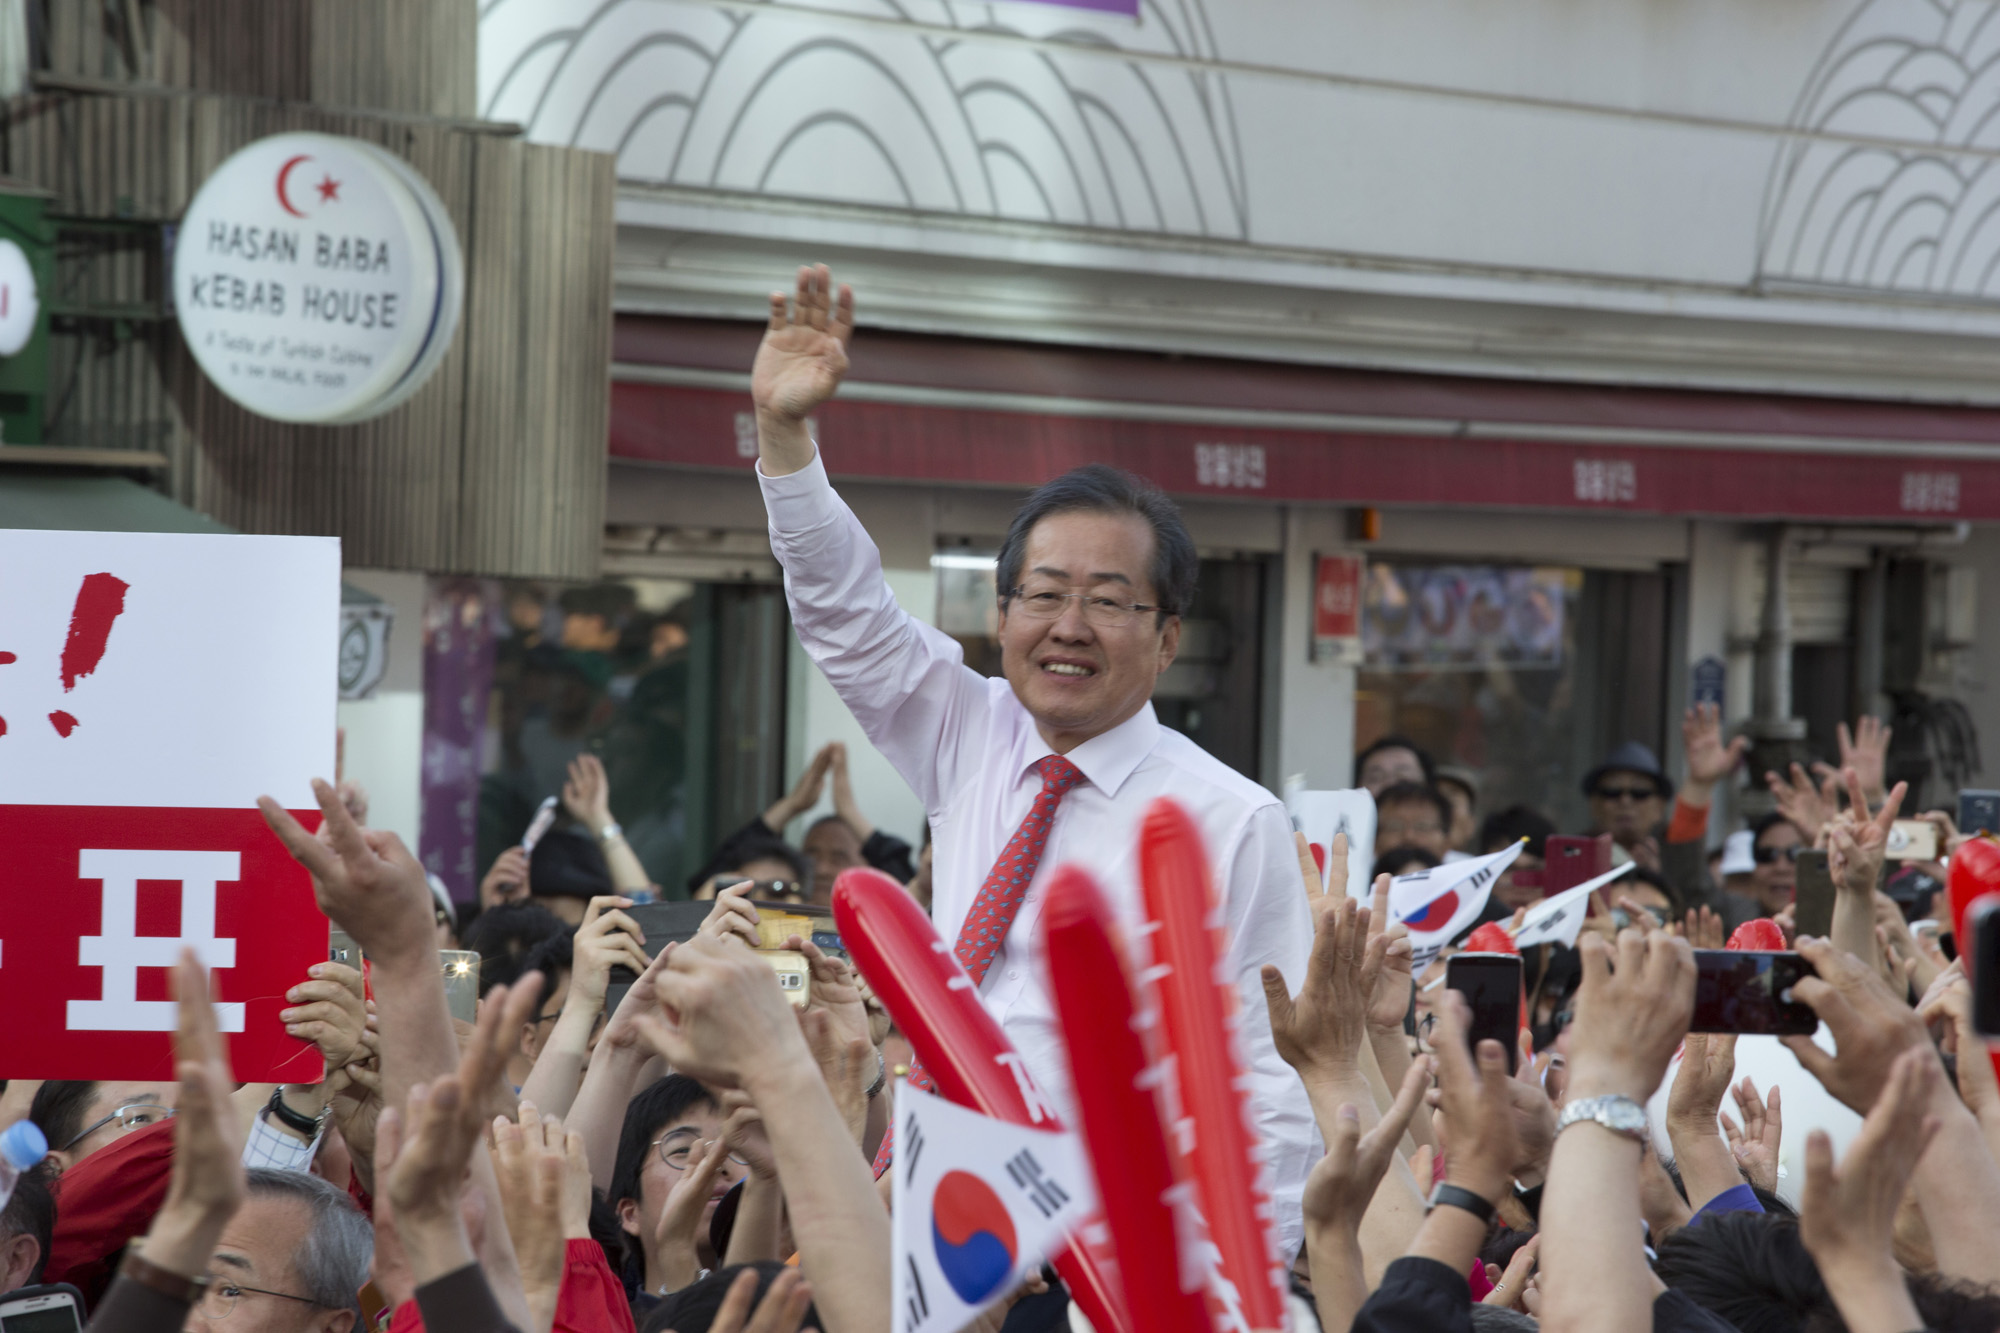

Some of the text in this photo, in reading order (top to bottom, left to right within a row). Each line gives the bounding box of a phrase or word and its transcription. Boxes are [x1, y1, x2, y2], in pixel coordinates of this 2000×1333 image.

[208, 220, 390, 274] HASAN BABA
[189, 274, 398, 329] KEBAB HOUSE
[66, 849, 245, 1032] 표
